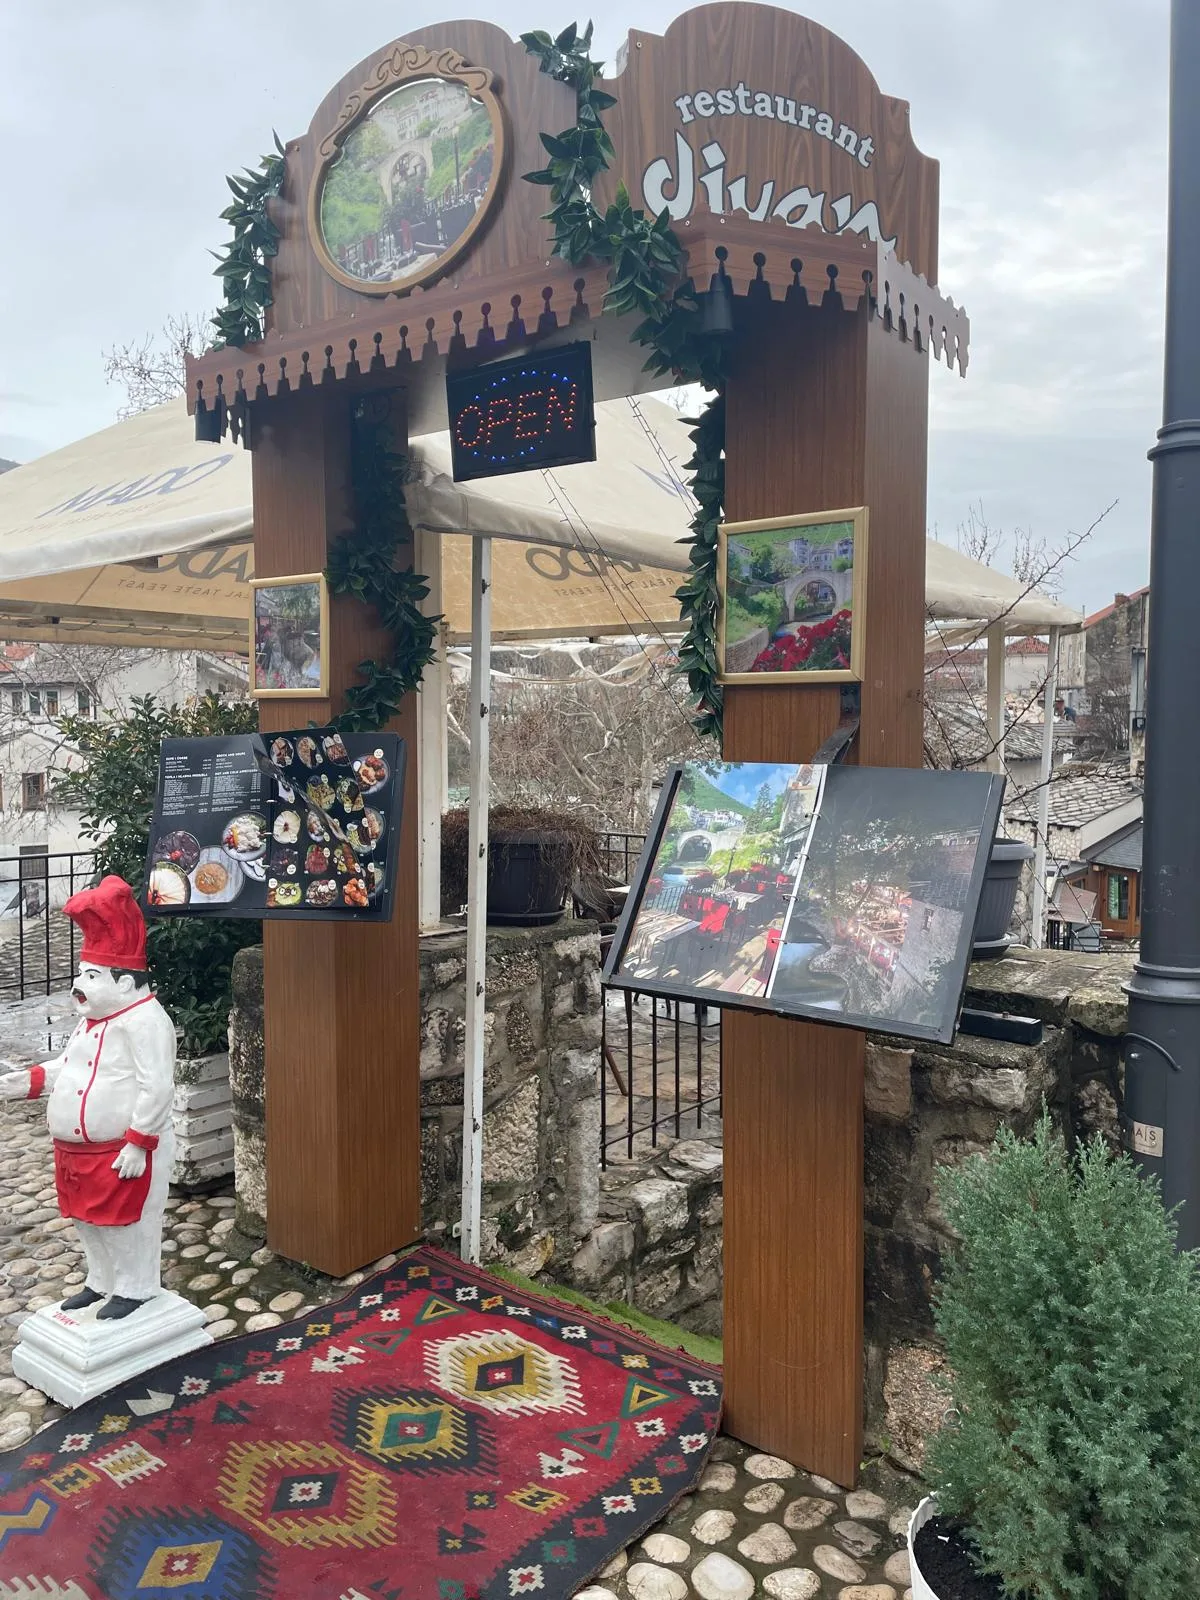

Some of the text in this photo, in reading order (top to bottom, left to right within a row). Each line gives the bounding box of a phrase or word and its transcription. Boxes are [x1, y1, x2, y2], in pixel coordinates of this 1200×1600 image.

[675, 82, 877, 168] restaurant
[642, 130, 897, 251] divan
[456, 384, 577, 448] OPEN
